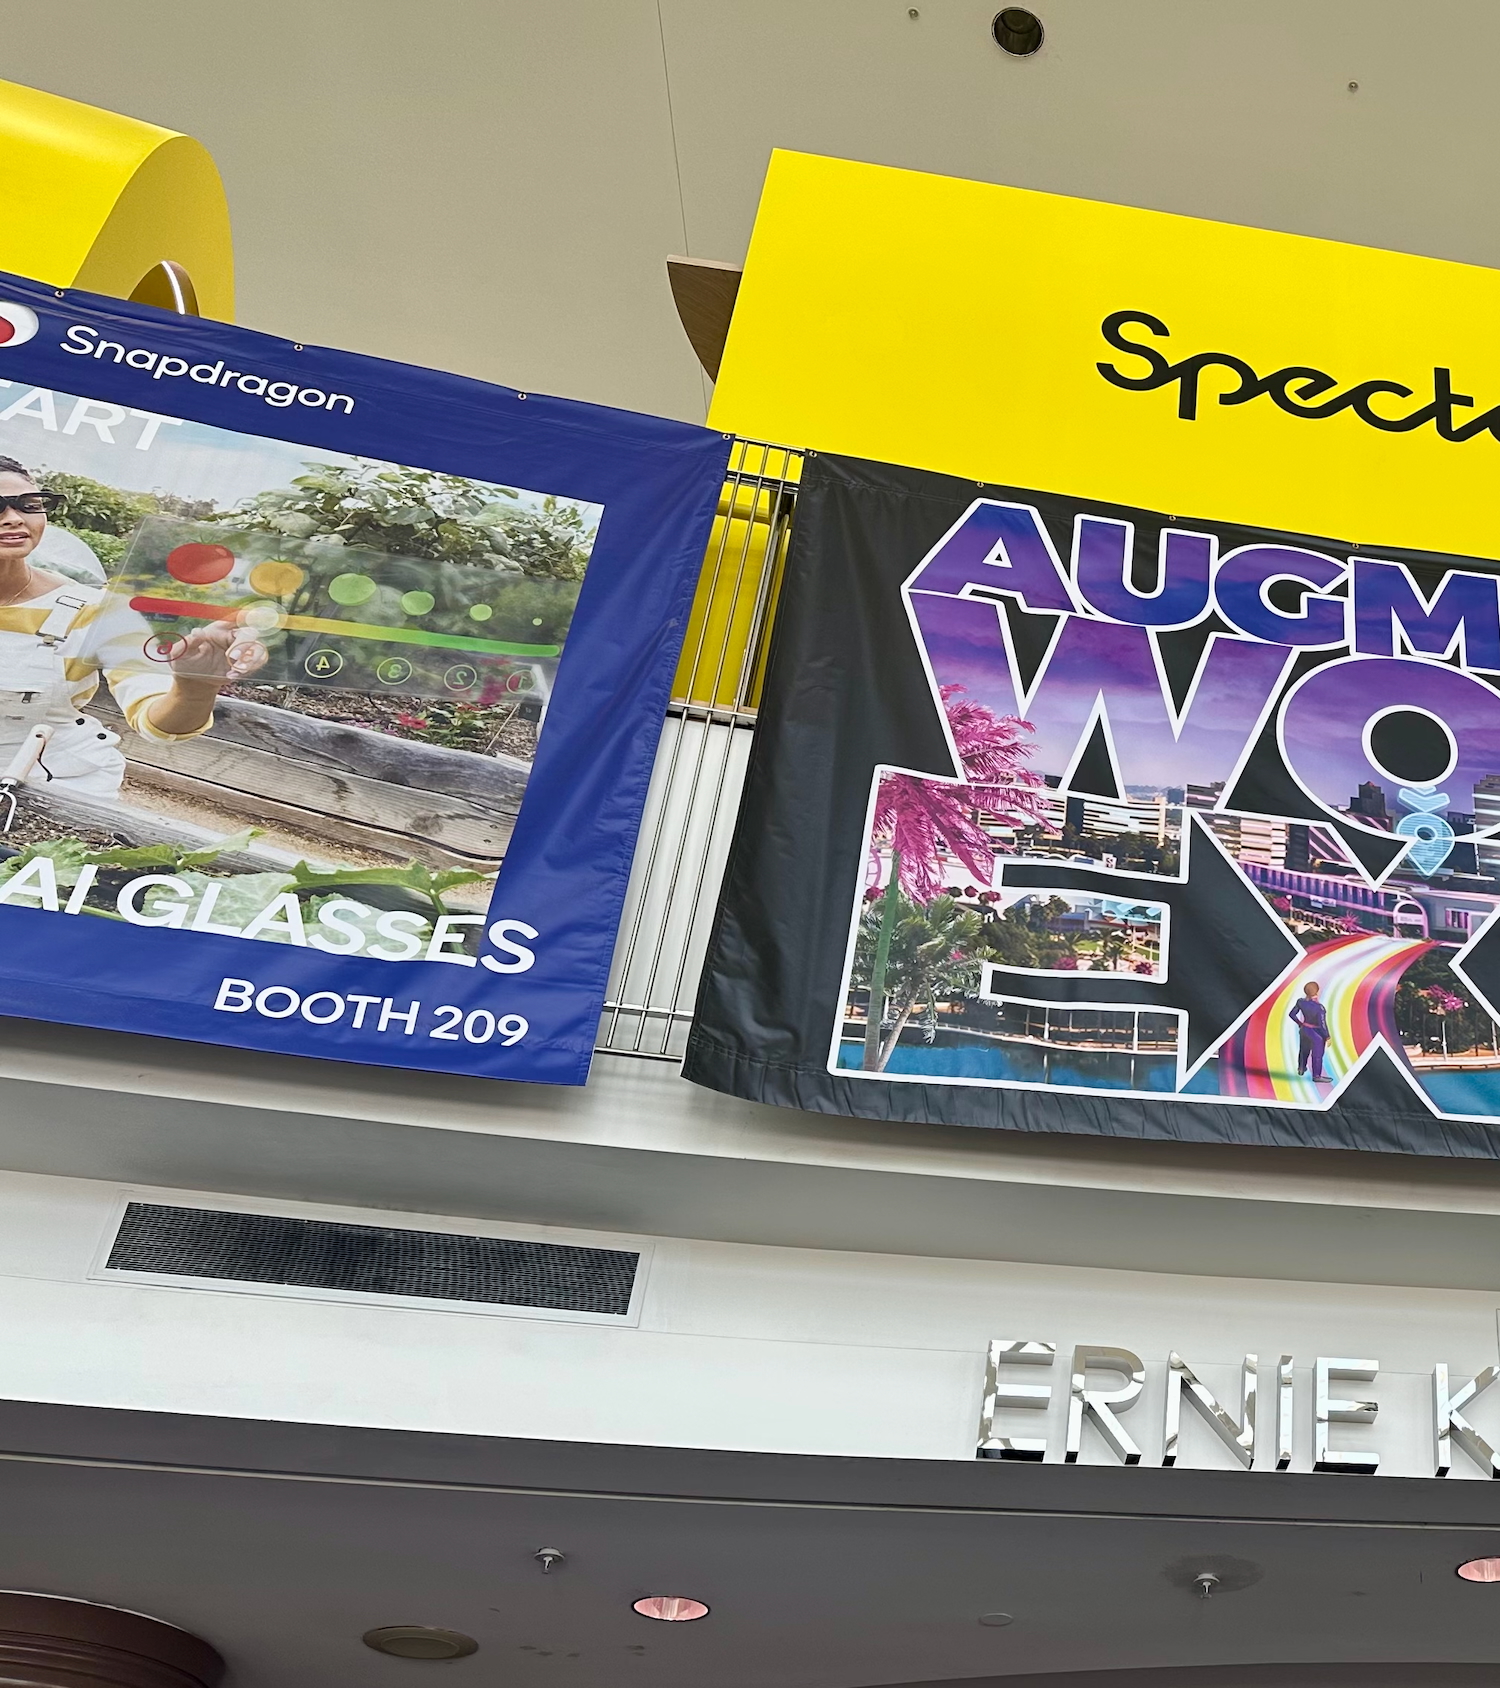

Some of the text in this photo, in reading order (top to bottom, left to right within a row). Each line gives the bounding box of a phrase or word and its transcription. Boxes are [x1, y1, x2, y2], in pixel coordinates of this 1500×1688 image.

[0, 378, 184, 452] ART
[60, 324, 357, 415] Snapdragon
[0, 856, 540, 975] AI GLASSES
[214, 978, 530, 1048] BOOTH 209
[976, 1338, 1380, 1475] ERNIE
